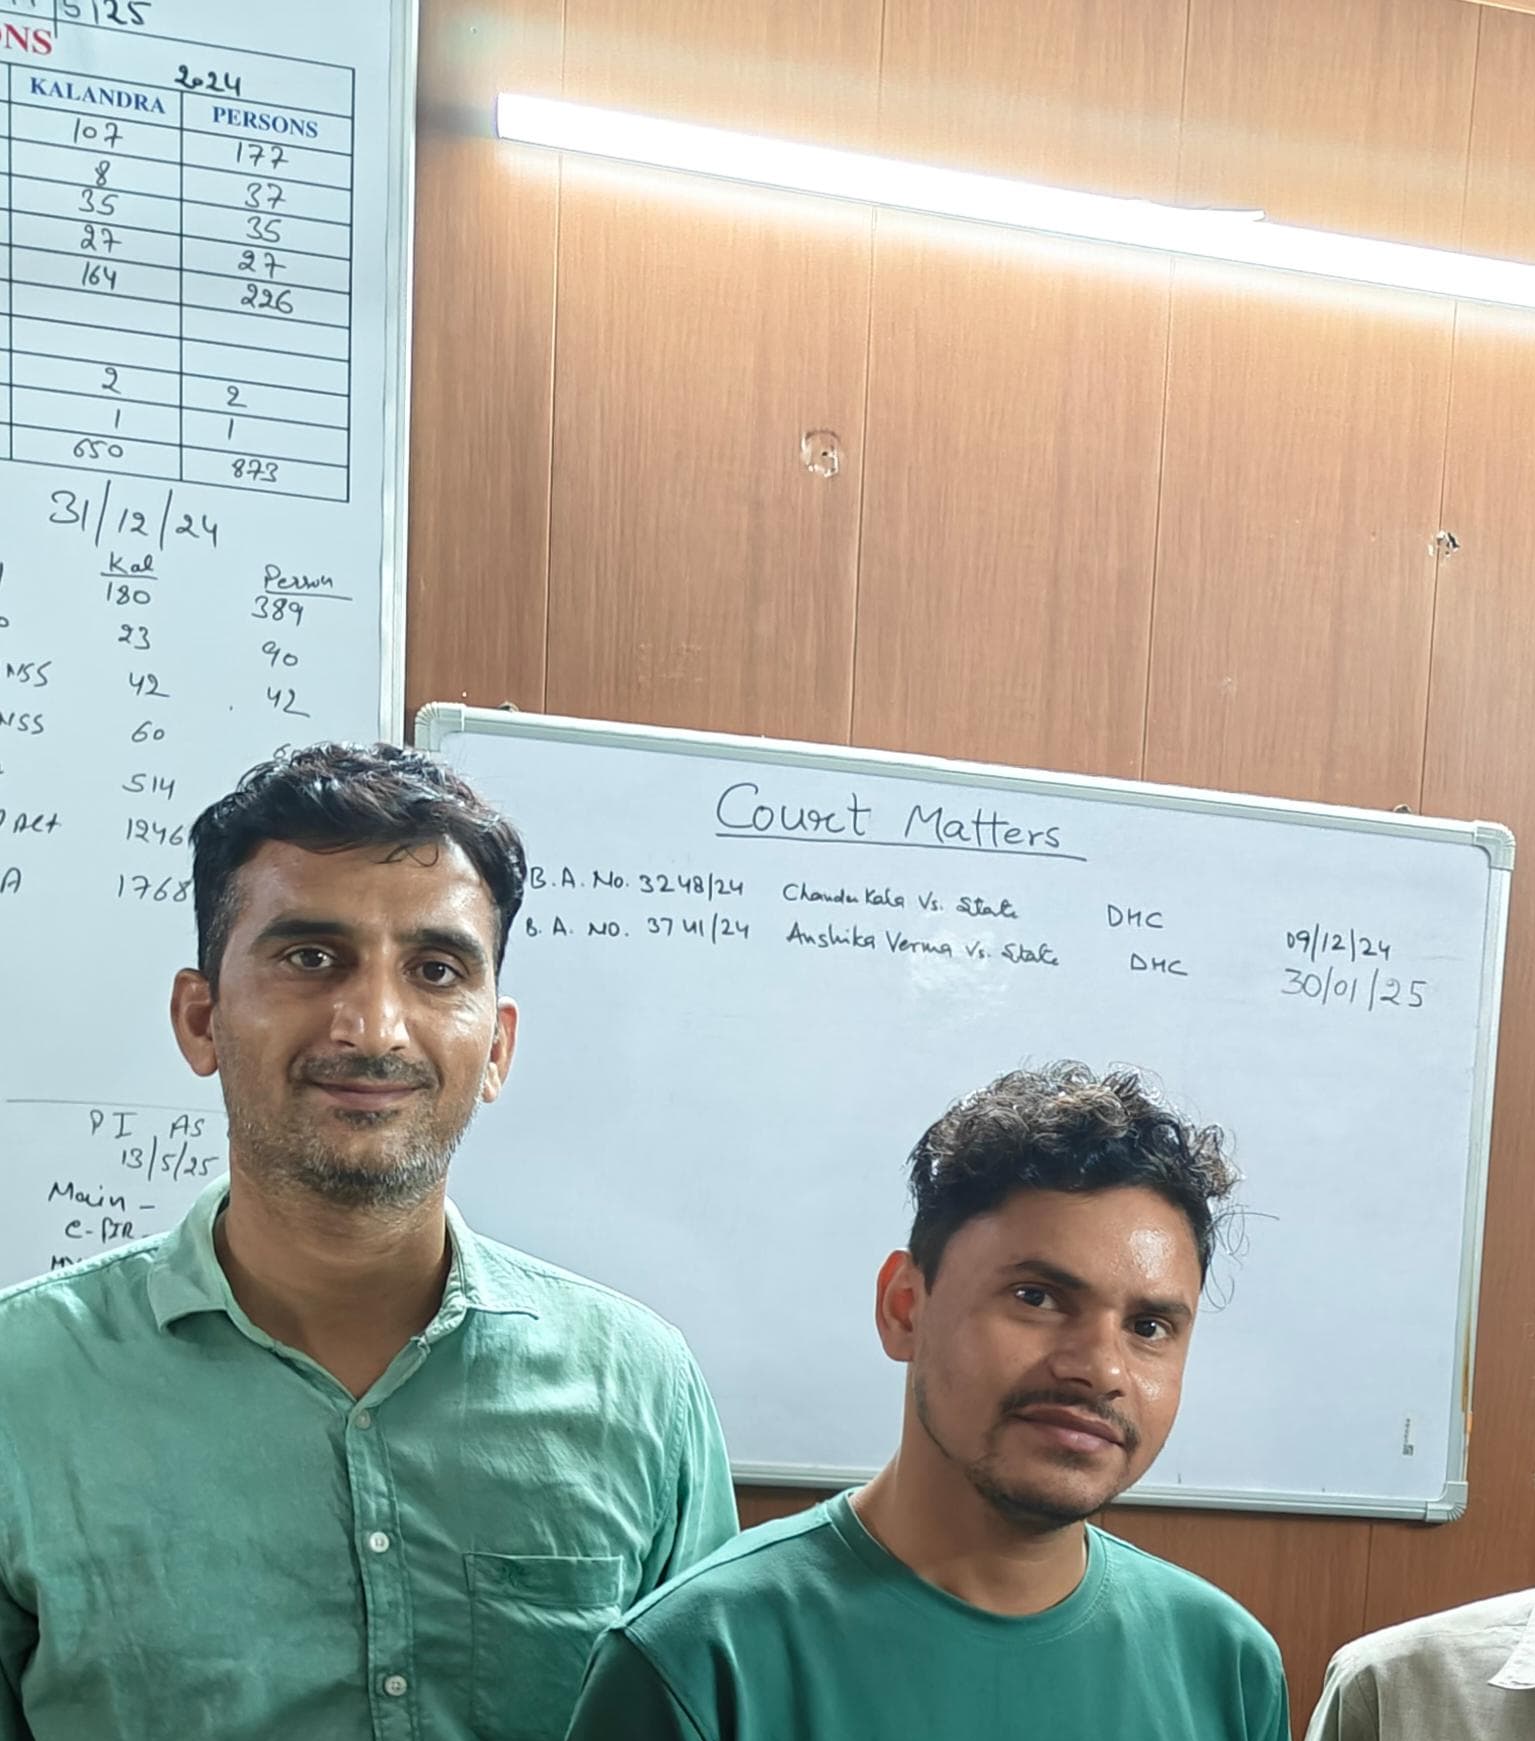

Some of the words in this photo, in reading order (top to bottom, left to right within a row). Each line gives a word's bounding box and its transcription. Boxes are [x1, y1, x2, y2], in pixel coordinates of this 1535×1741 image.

[0, 23, 53, 55] NS
[30, 76, 166, 114] KALANDRA
[73, 117, 124, 148] 107
[212, 106, 318, 139] PERSONS
[235, 141, 289, 169] 177
[95, 160, 111, 187] 8
[78, 189, 119, 216] 35
[243, 183, 287, 208] 37
[80, 224, 122, 252] 27
[245, 218, 282, 244] 35
[82, 262, 117, 290] 164
[237, 253, 287, 279] 27
[241, 283, 294, 314] 226
[102, 367, 122, 395] 2
[226, 385, 248, 408] 2
[73, 439, 124, 459] 650
[231, 460, 280, 483] 873
[48, 479, 220, 550] 31/12/24
[106, 581, 152, 605] 180
[251, 595, 305, 626] 389
[262, 640, 299, 668] 90
[129, 672, 171, 698] 42
[266, 686, 311, 719] 42
[131, 720, 166, 743] 60
[122, 772, 176, 800] 514
[716, 783, 872, 836] Court
[903, 804, 1062, 850] Matters
[125, 818, 185, 847] 1246
[117, 874, 191, 902] 1768
[639, 872, 744, 901] 3248/24
[1107, 904, 1164, 929] DHC
[1286, 923, 1392, 962] 09/12/24
[1130, 953, 1188, 976] DHC
[1280, 966, 1428, 1011] 30/01/25
[121, 1136, 219, 1182] 13/5/25
